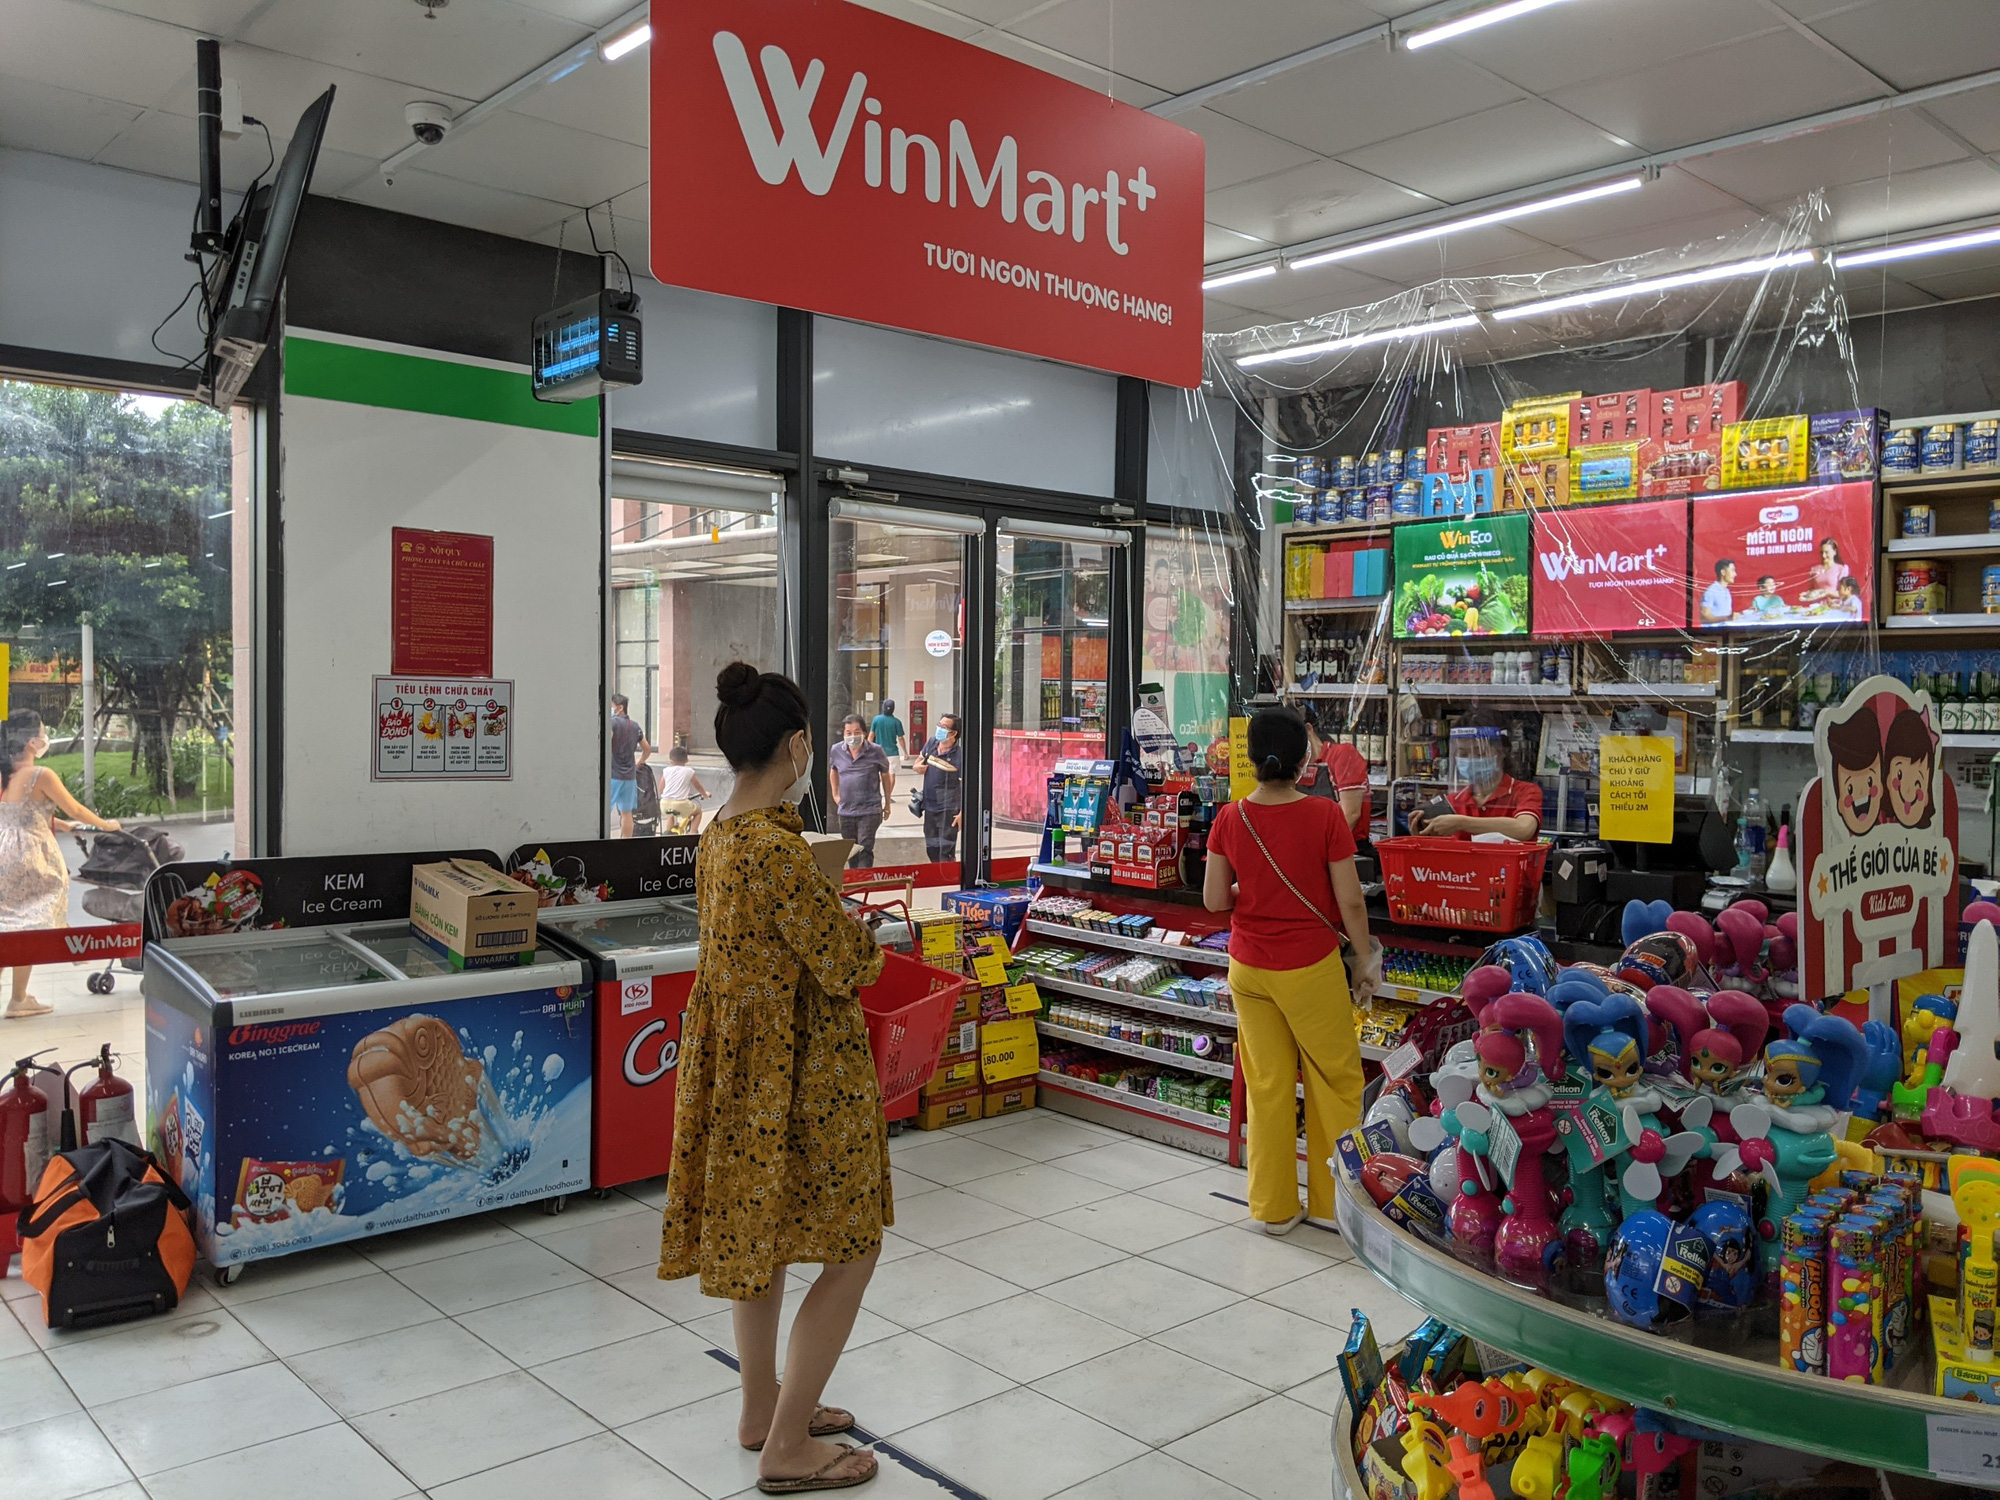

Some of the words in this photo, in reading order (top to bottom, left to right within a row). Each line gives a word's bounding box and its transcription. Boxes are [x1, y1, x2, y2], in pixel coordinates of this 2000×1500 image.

[712, 30, 1157, 256] WinMart+
[923, 242, 975, 276] TƯƠI
[980, 256, 1040, 292] NGON
[1044, 272, 1120, 309] THƯỢNG
[1123, 293, 1172, 326] HẠNG!
[395, 683, 416, 695] TIÊU
[419, 683, 442, 697] LỆNH
[471, 684, 494, 696] CHÁY
[1608, 754, 1636, 763] KHÁCH
[1638, 753, 1662, 763] HÀNG
[1610, 789, 1632, 799] CÁCH
[1411, 866, 1477, 884] WinMart+
[1829, 845, 1858, 893] THẾ
[1860, 845, 1890, 880] GIỚI
[1893, 837, 1920, 876] CỦA
[1923, 845, 1938, 877] BÉ
[324, 872, 365, 891] KEM
[639, 876, 662, 893] Ice
[666, 873, 698, 890] Cre
[302, 899, 326, 914] Ice
[330, 897, 382, 912] Cream
[958, 899, 991, 922] Tiger
[1869, 893, 1888, 915] Kids
[1888, 891, 1907, 911] Zone
[444, 921, 459, 939] KEM
[64, 933, 141, 955] WinMar
[474, 954, 516, 965] VINAMILK
[228, 1020, 321, 1046] Binggrae
[228, 1051, 257, 1062] KOREA
[258, 1047, 278, 1057] NO.1
[278, 1042, 321, 1055] ICECREAM
[983, 1050, 1015, 1066] 180.000
[1587, 1108, 1613, 1144] Relkon
[1409, 1194, 1438, 1219] Relkon
